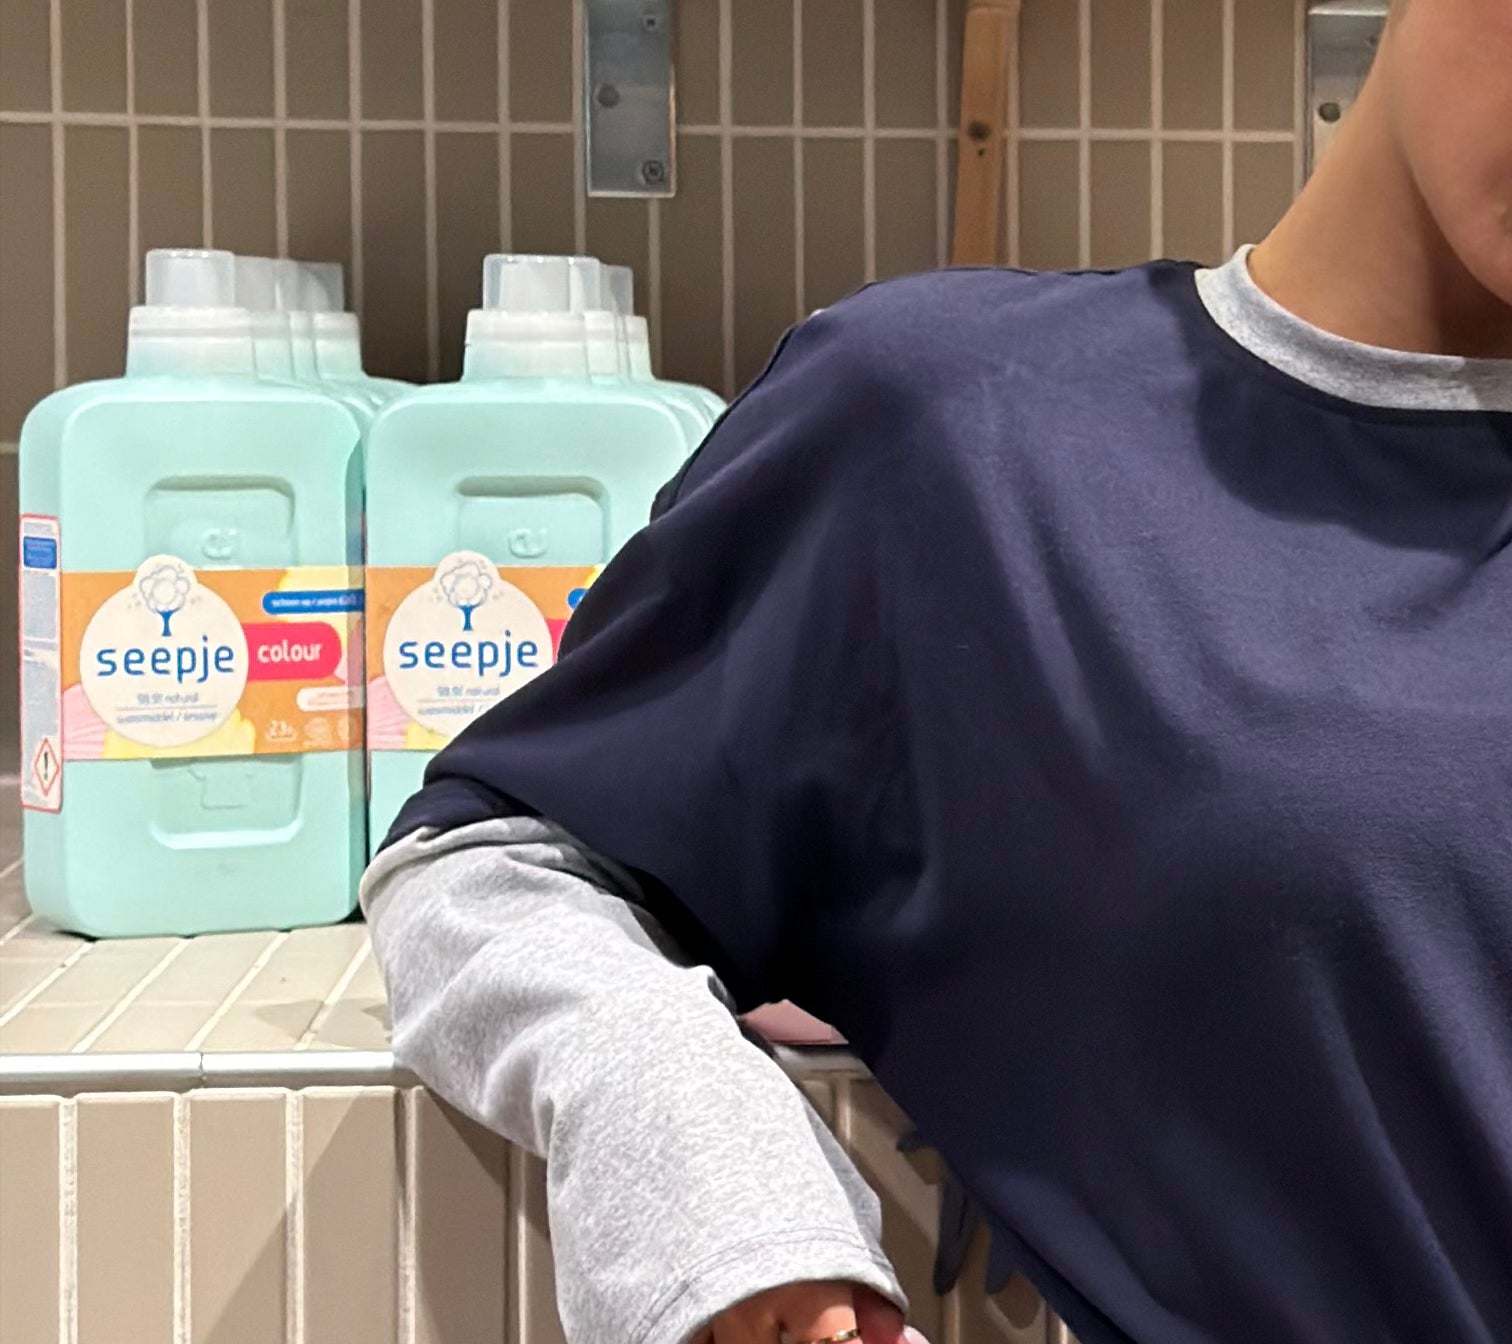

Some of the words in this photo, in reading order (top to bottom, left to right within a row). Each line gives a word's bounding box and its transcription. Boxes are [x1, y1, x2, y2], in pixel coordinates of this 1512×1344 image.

[97, 635, 234, 684] seepje
[257, 639, 323, 664] colour
[399, 629, 538, 678] seepje
